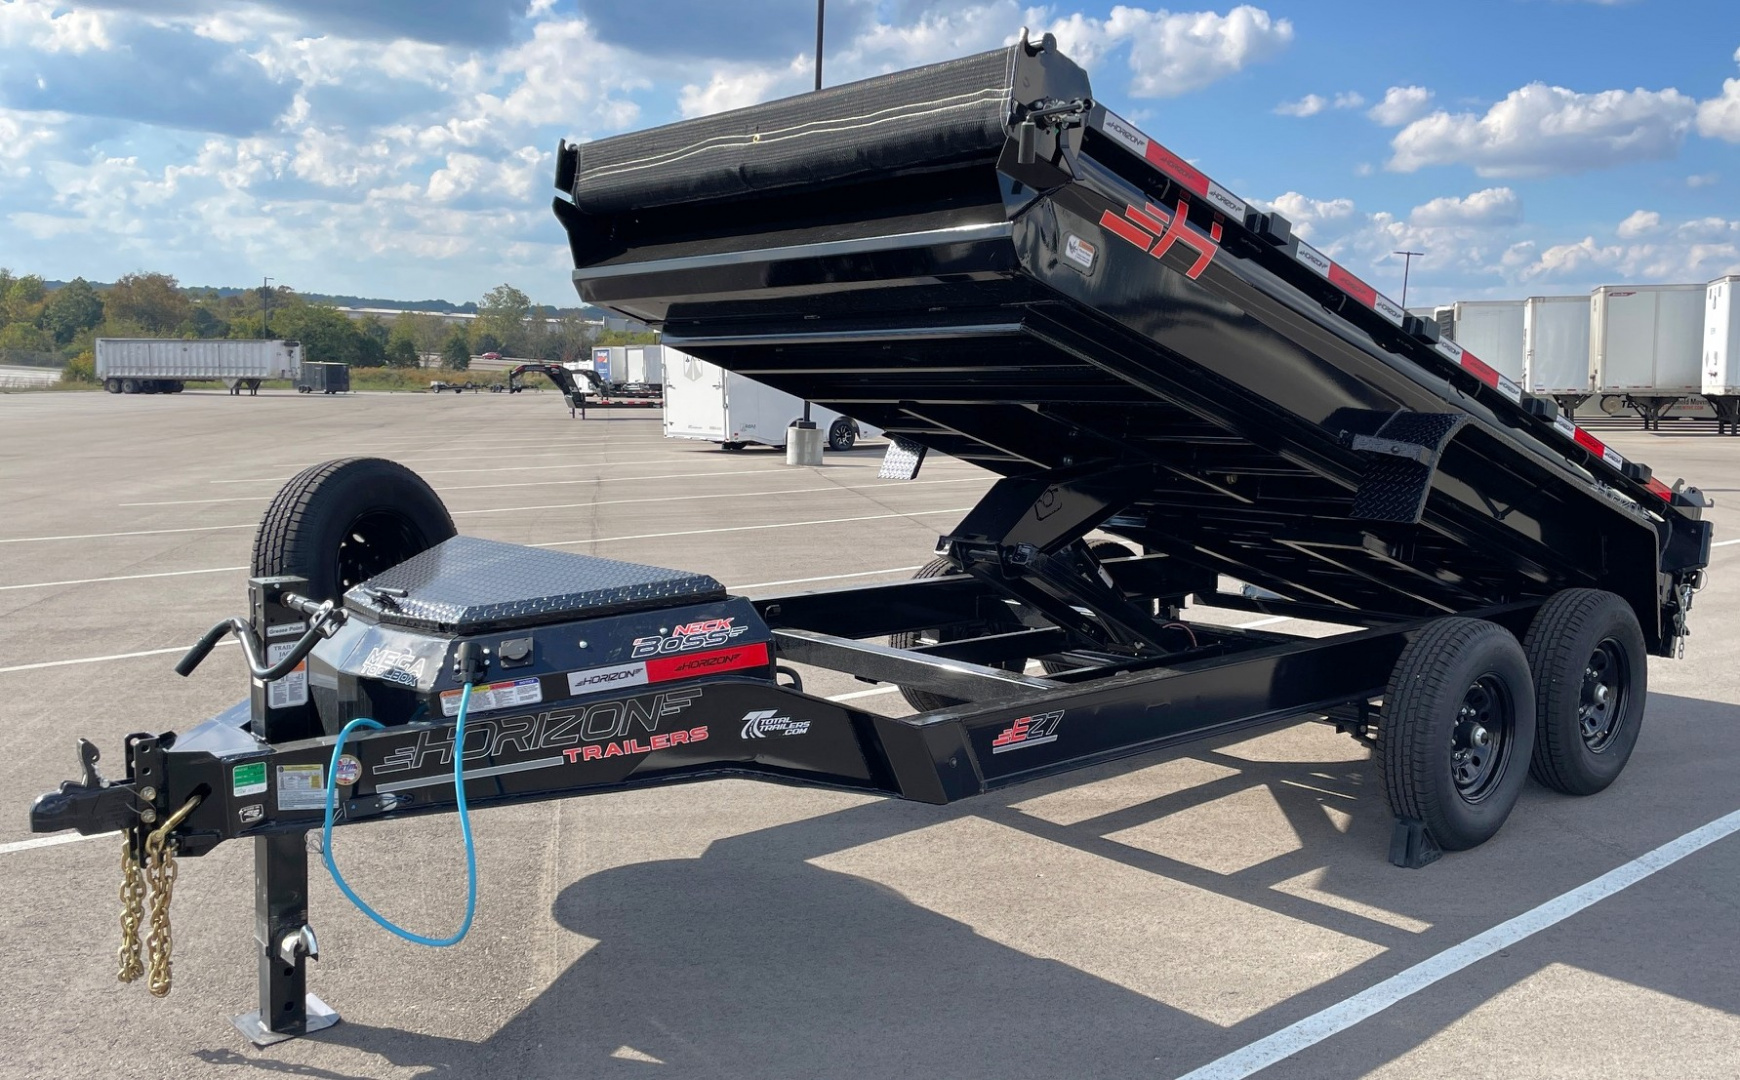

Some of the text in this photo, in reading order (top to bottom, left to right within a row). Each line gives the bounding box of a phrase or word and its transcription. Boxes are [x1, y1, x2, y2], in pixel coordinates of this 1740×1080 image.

[1110, 121, 1141, 146] HORIZON
[1212, 191, 1240, 212] HORIZON
[269, 627, 288, 635] Grease
[672, 617, 735, 637] NECK
[631, 628, 731, 658] BOSS
[363, 648, 426, 678] MEGA
[681, 654, 735, 671] HORIZON
[361, 662, 417, 686] TOOLBOX
[582, 669, 636, 686] HORIZON
[759, 720, 811, 732] TRAILERS
[760, 717, 792, 725] TOTAL
[410, 695, 667, 769] HORIZON
[782, 728, 808, 736] .COM
[563, 725, 710, 764] TRAILERS
